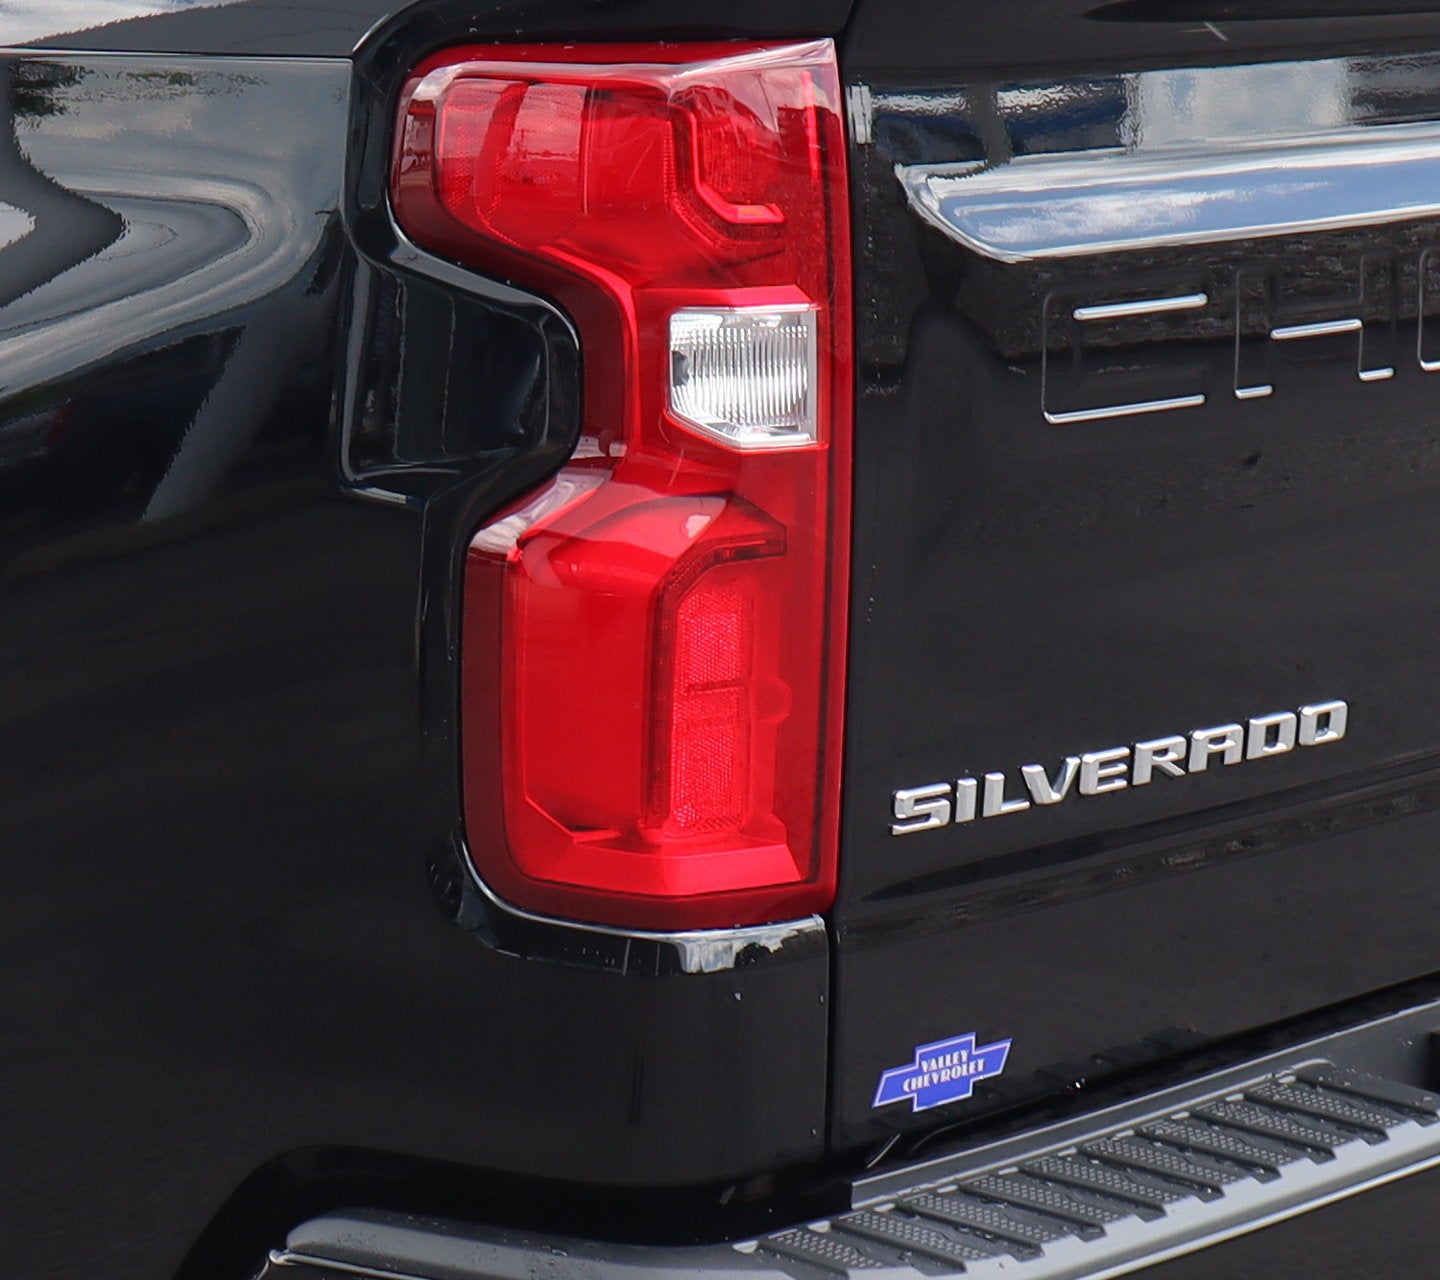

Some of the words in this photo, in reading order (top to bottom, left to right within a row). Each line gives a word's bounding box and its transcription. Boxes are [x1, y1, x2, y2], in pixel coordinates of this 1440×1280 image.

[890, 699, 1349, 836] SILVERADO
[902, 1057, 986, 1092] CHEVROLET
[921, 1049, 969, 1073] VALLEY
